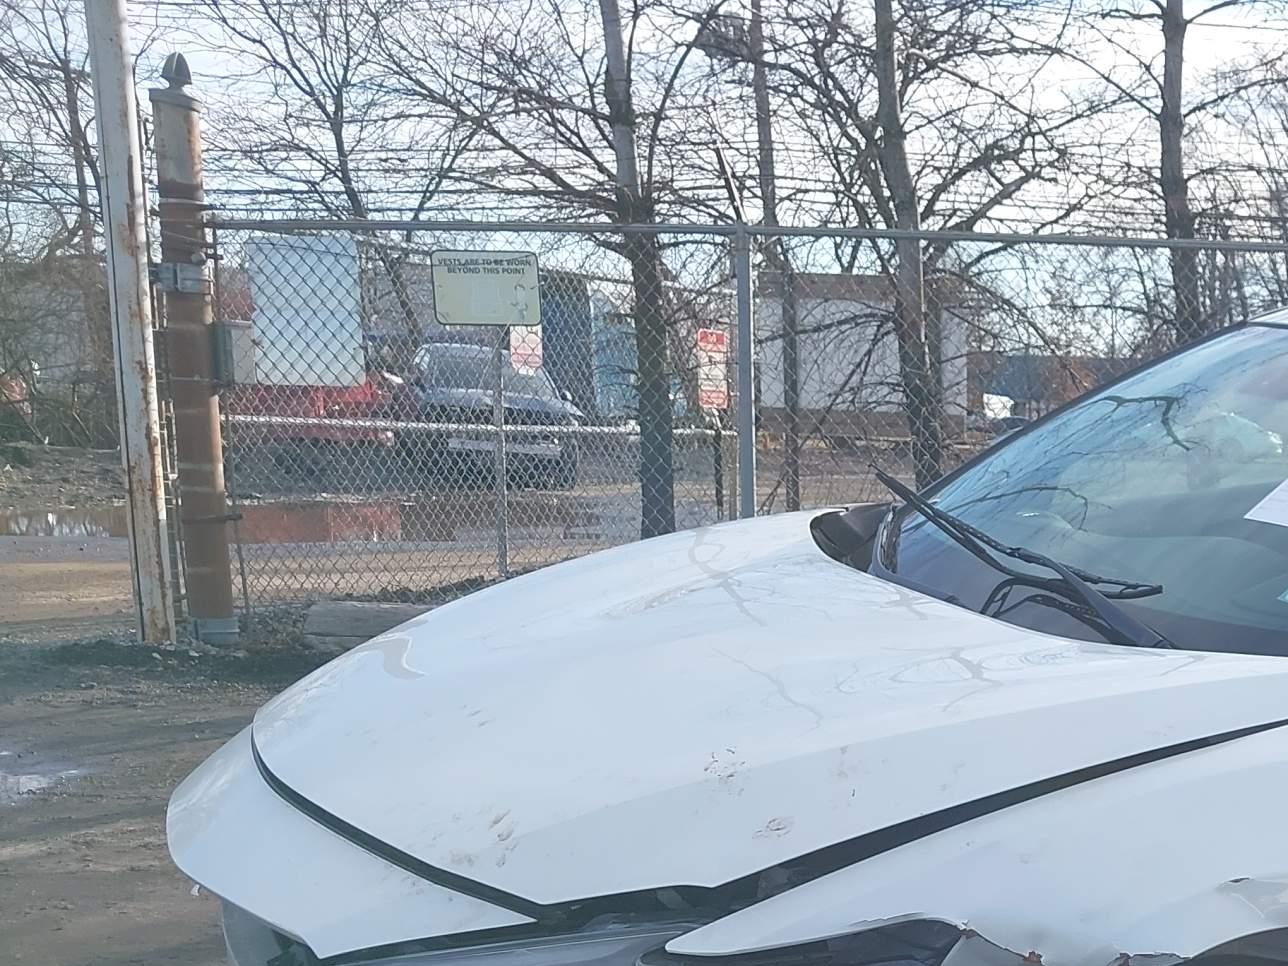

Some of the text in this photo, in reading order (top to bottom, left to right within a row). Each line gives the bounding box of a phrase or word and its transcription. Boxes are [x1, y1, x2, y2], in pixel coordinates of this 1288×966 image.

[505, 259, 532, 267] WORN
[482, 267, 500, 275] THIS
[502, 267, 526, 275] POINT
